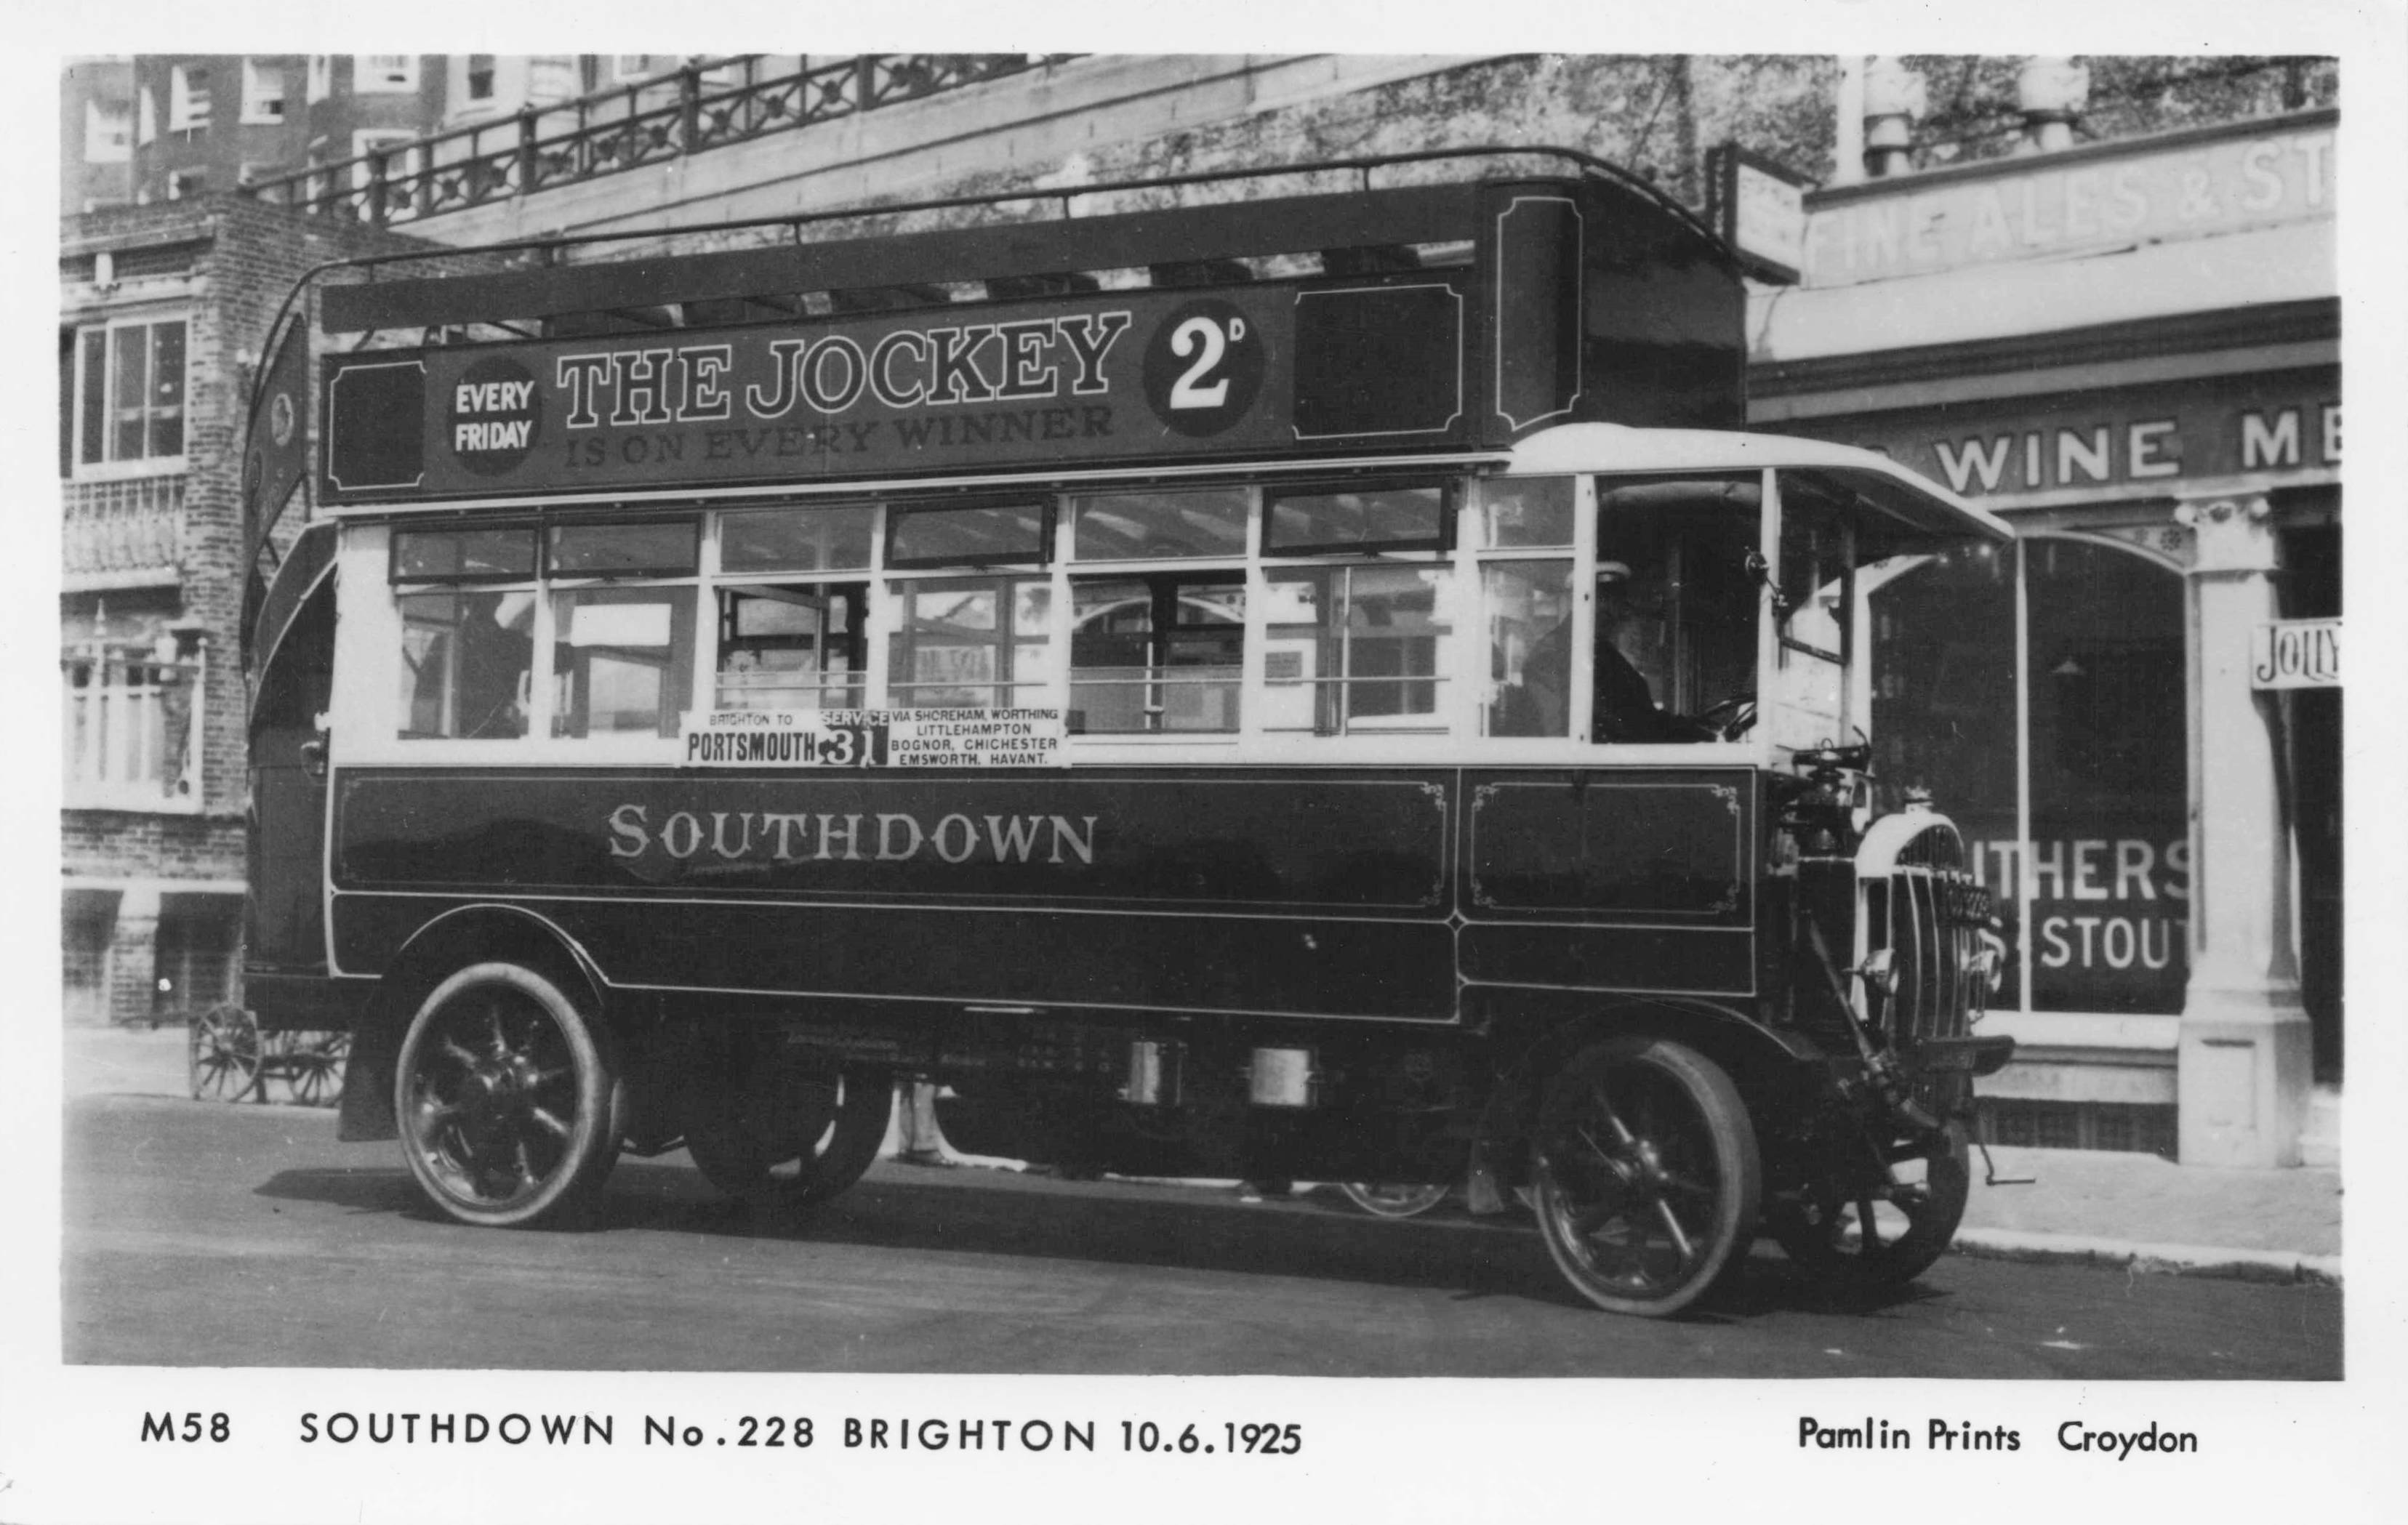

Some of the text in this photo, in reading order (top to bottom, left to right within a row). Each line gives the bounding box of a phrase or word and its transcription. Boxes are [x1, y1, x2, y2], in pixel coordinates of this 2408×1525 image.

[1807, 211, 1943, 273] FINE
[1971, 167, 2148, 250] ALES
[2183, 166, 2219, 217] &
[557, 310, 1131, 428] THE JOCKEY
[456, 380, 534, 413] EVERY
[455, 420, 532, 451] FRIDAY
[564, 406, 1114, 467] IS ON EVERY WINNER
[1935, 421, 2179, 492] WINE
[2256, 625, 2340, 683] JOLLY
[710, 715, 793, 725] BRIGHTON TO
[822, 711, 889, 726] SERVICE
[892, 711, 910, 722] VIA
[991, 709, 1058, 720] WORTHING
[917, 723, 1032, 736] LITTLEHAMPTON
[688, 732, 815, 762] PORTSMOUTH
[827, 729, 876, 768] 31
[964, 738, 1058, 750] CHICHESTER
[609, 804, 1098, 864] SOUTHDOWN
[2041, 917, 2190, 969] STOU
